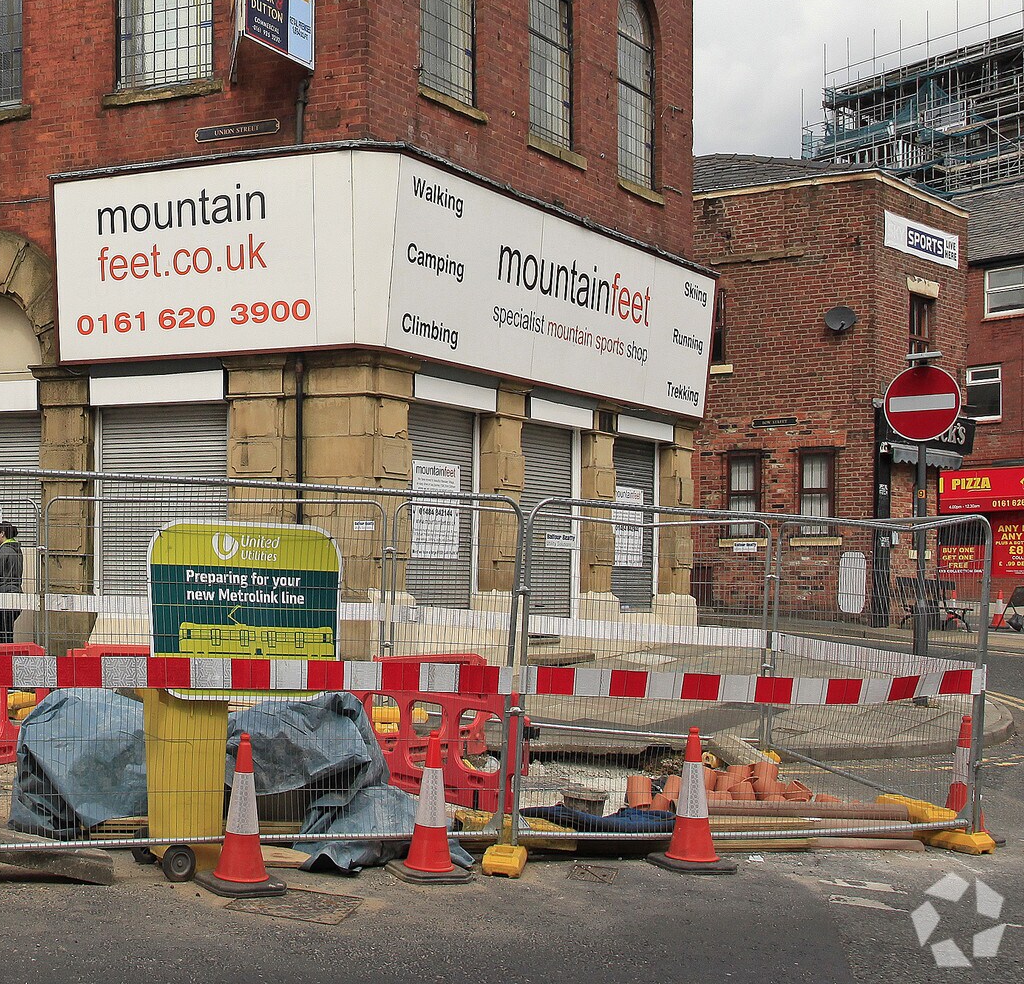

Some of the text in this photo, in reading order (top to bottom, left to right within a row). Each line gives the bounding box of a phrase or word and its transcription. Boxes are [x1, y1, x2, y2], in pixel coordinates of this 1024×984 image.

[214, 125, 260, 136] UNION STREET
[97, 183, 266, 235] mountain
[413, 175, 464, 218] Walking
[908, 230, 943, 255] SPORTS
[945, 240, 956, 251] LIVE
[98, 234, 267, 281] feet.co.uk
[407, 243, 464, 282] Camping
[945, 250, 957, 261] HERE
[497, 244, 651, 327] mountainfeet
[684, 281, 708, 307] Skiing
[76, 298, 311, 336] 0161 620 3900
[402, 313, 459, 350] Climbing
[492, 305, 648, 366] specialist mountain sports shop
[673, 328, 704, 355] Running
[666, 381, 700, 407] Trekking
[416, 465, 456, 478] mountainfeet
[951, 477, 991, 491] PIZZA
[997, 524, 1019, 532] ANY
[241, 535, 280, 549] United
[241, 550, 277, 562] Utilities
[186, 569, 301, 589] Preparing for your
[186, 589, 305, 604] new Metrolink line
